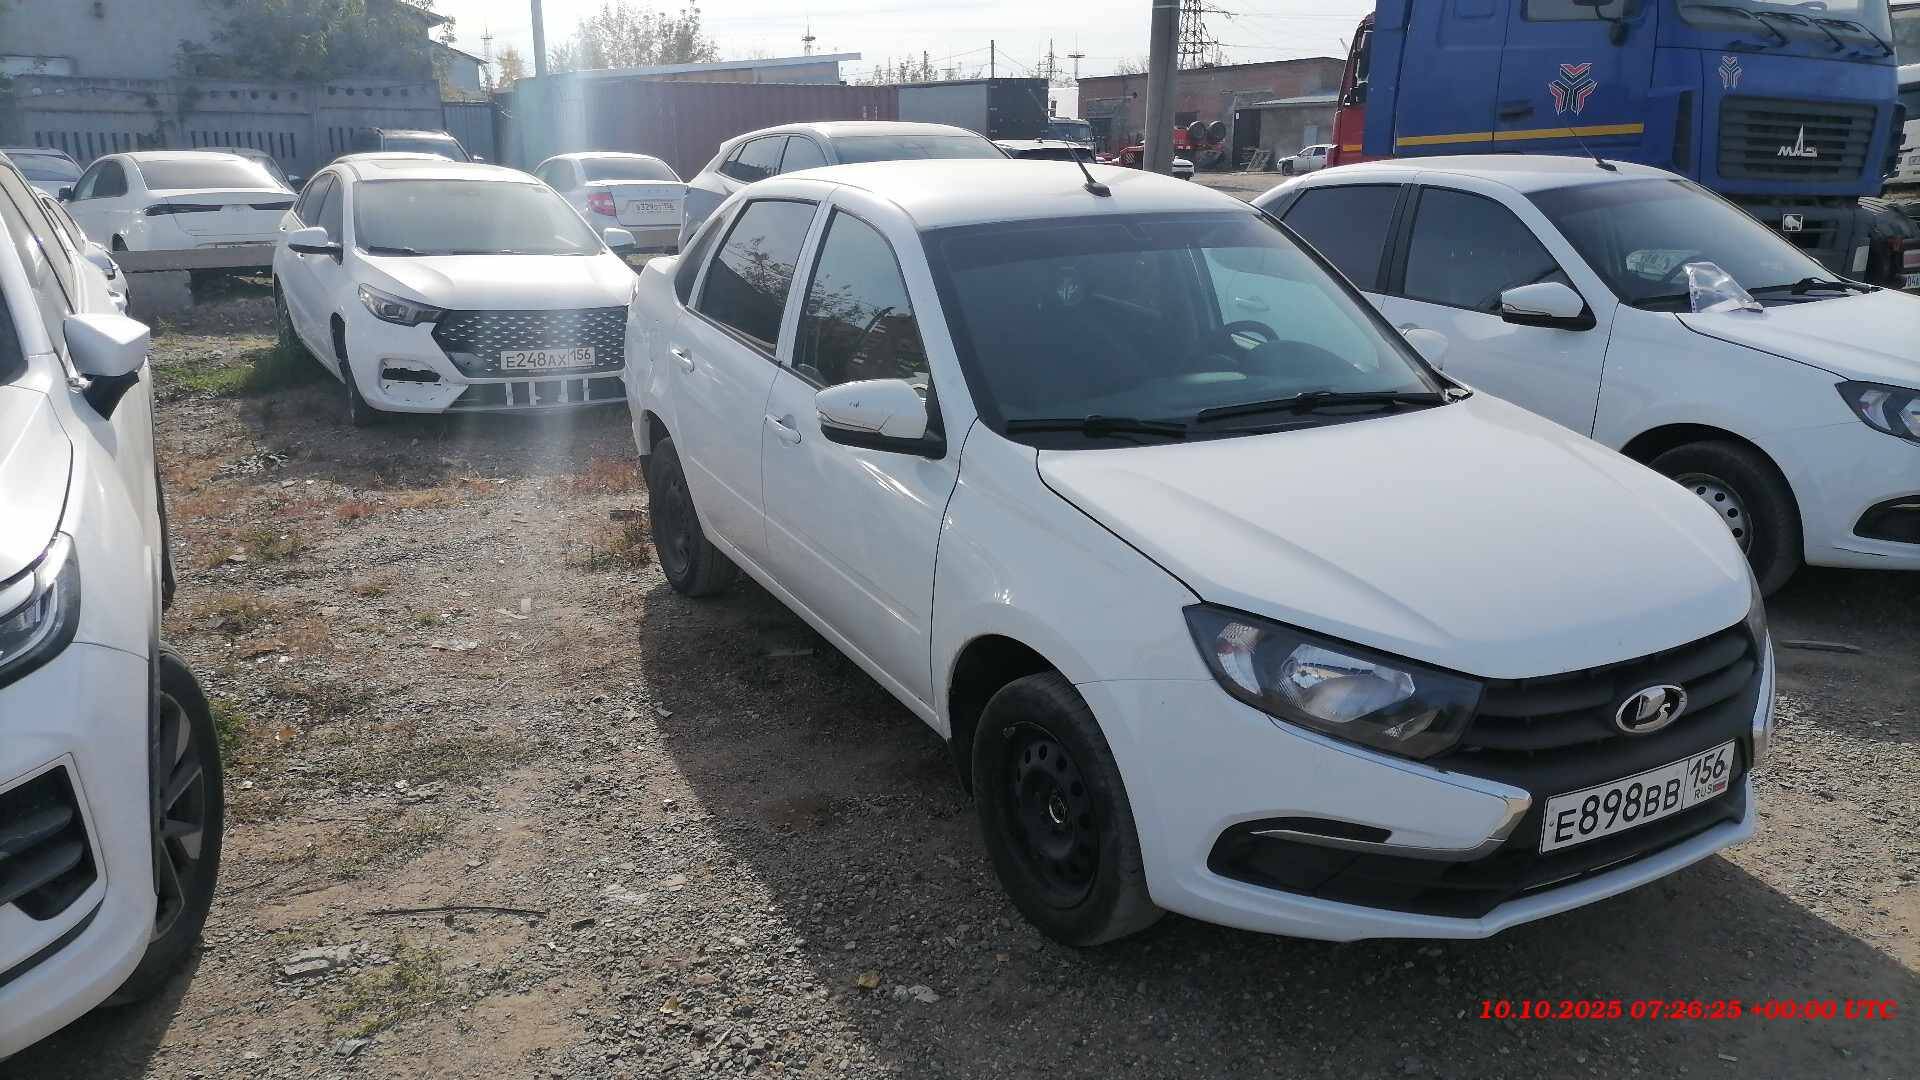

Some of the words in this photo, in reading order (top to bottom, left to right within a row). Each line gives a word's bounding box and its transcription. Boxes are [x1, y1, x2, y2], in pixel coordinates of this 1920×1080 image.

[569, 348, 591, 361] 156
[1554, 778, 1680, 843] Е898ВВ
[1690, 749, 1726, 788] 156
[1694, 783, 1713, 799] RUS
